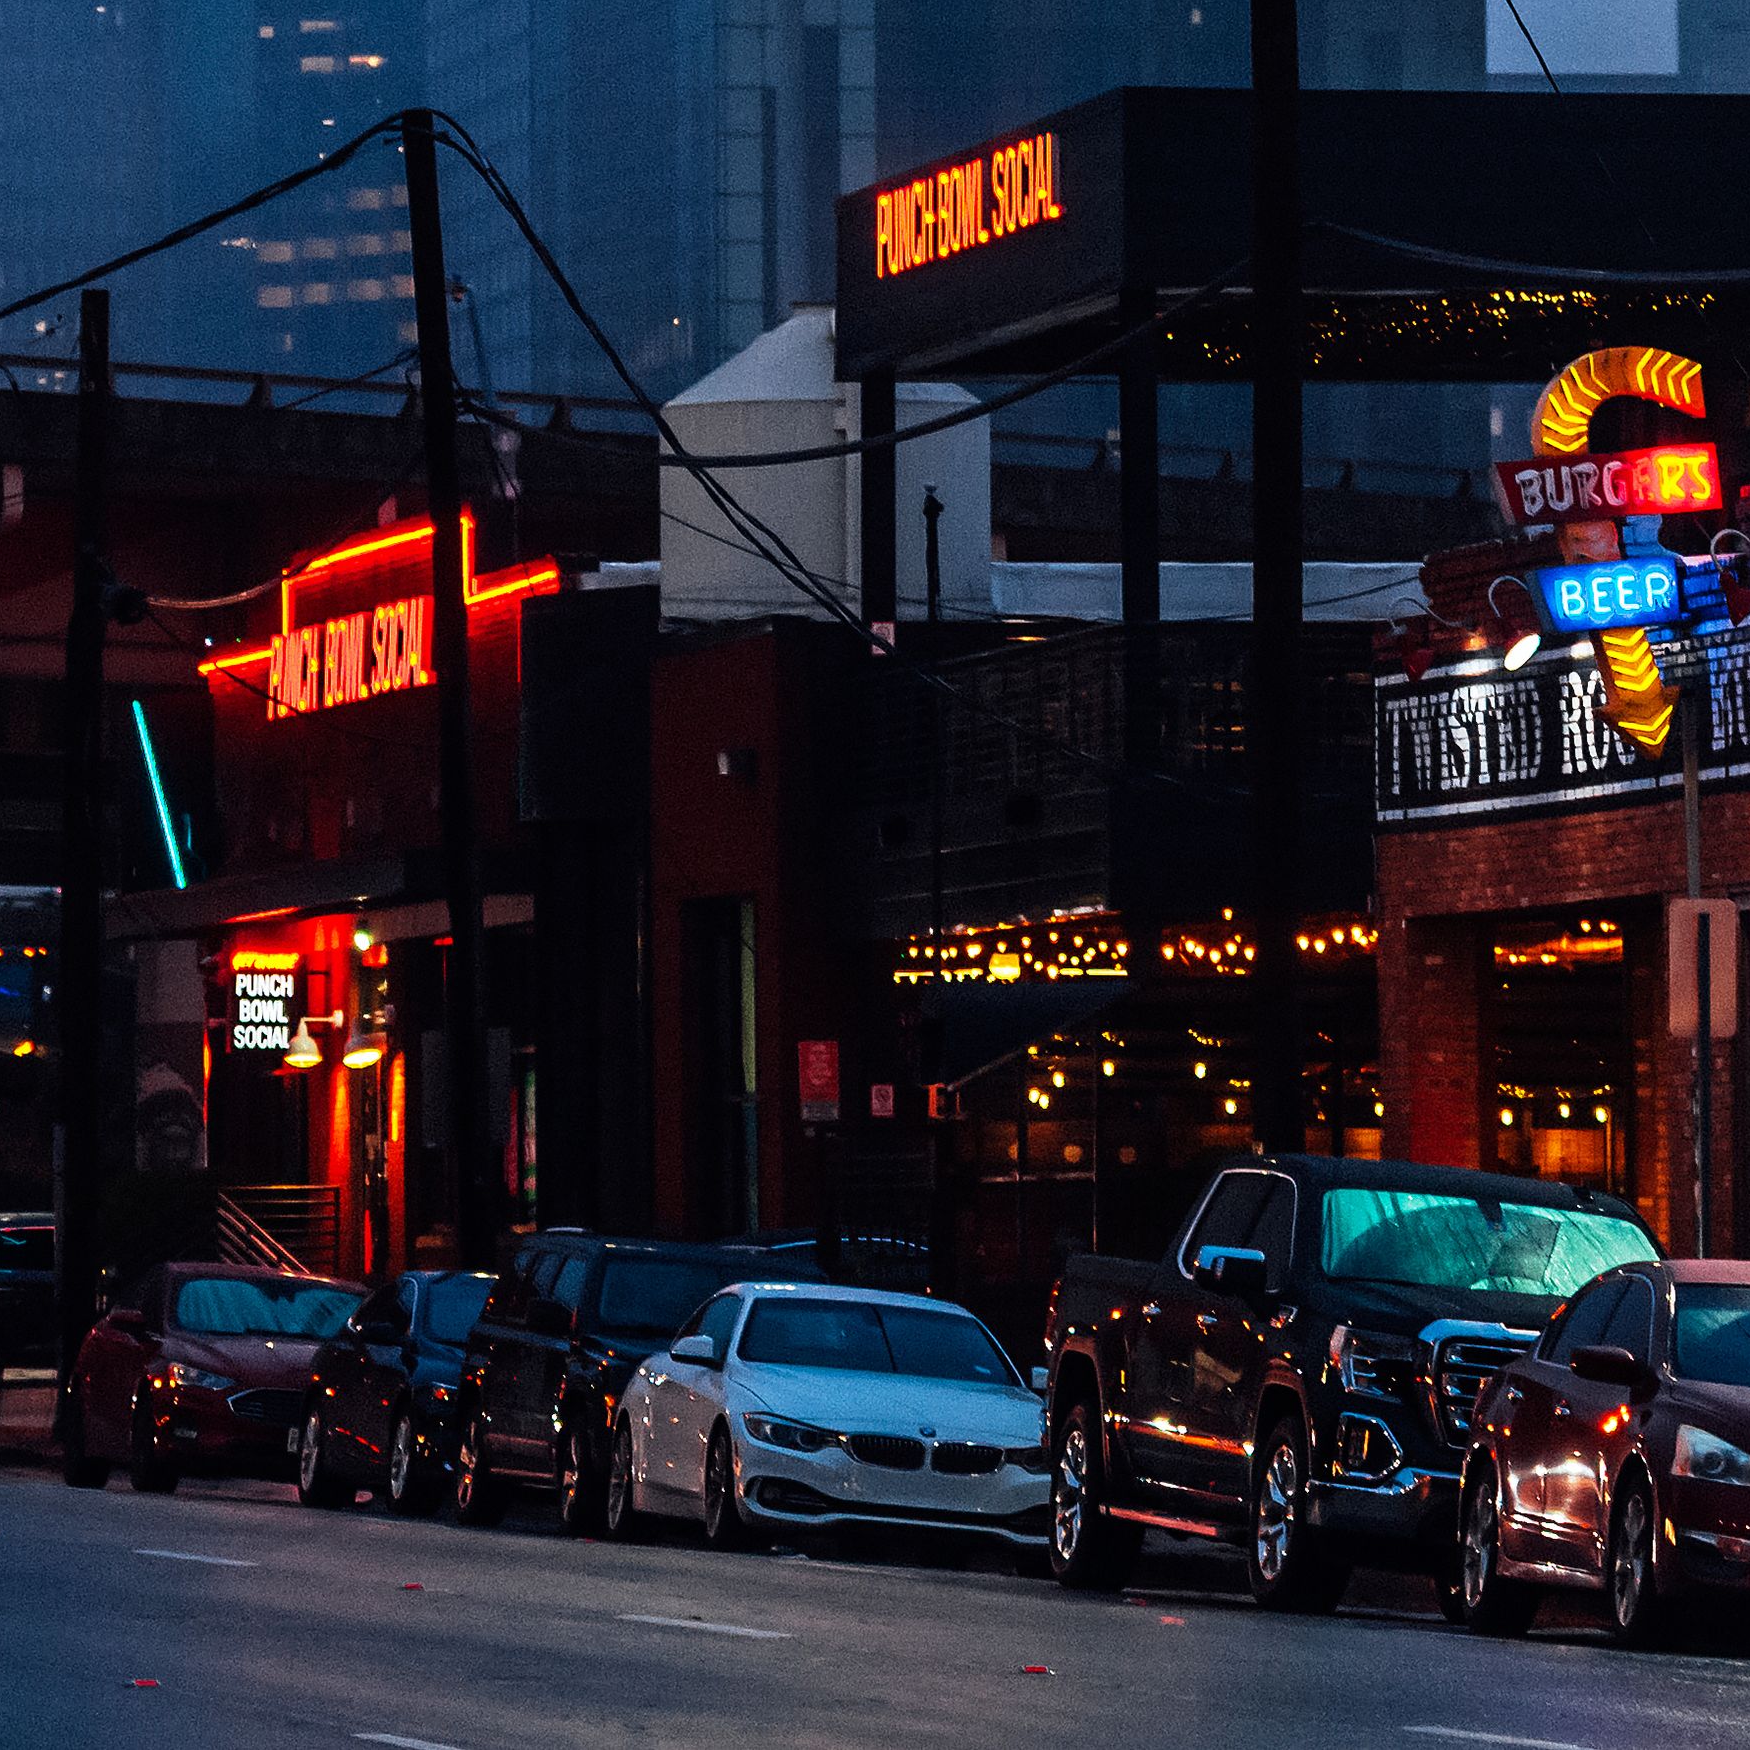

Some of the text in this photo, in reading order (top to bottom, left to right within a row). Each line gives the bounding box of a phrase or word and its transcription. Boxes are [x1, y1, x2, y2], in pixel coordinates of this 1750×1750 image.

[877, 131, 1061, 279] PUNCH BOWL SOCIAL
[1514, 451, 1712, 518] BURGERS
[1556, 570, 1671, 620] BEER
[267, 595, 436, 722] PUNCH BOWL SOCIAL
[1385, 678, 1543, 795] TWISTED
[1558, 669, 1637, 776] RO
[235, 973, 295, 998] PUNCH
[238, 998, 290, 1024] BOWL
[233, 1024, 291, 1050] SOCIAL
